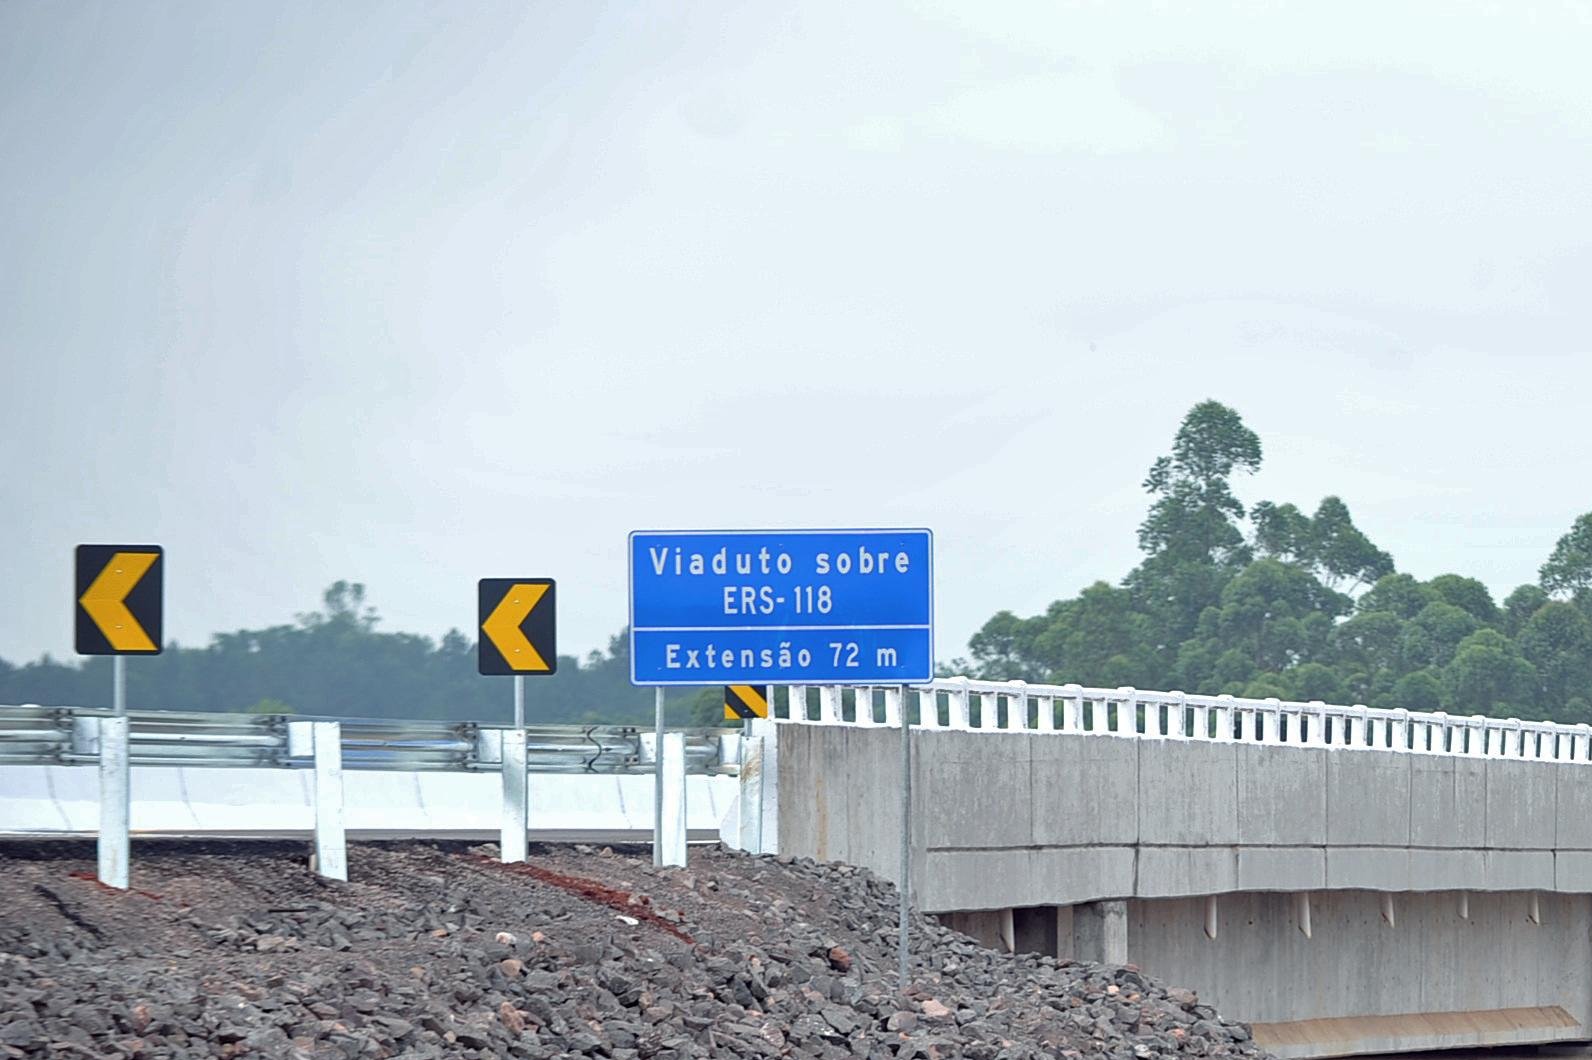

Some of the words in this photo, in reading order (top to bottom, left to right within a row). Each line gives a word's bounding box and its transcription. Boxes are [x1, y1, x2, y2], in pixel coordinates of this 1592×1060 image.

[649, 547, 792, 575] Viaduto
[816, 546, 909, 574] sobre
[666, 641, 811, 668] Extensão
[829, 642, 859, 667] 72
[876, 648, 897, 667] m
